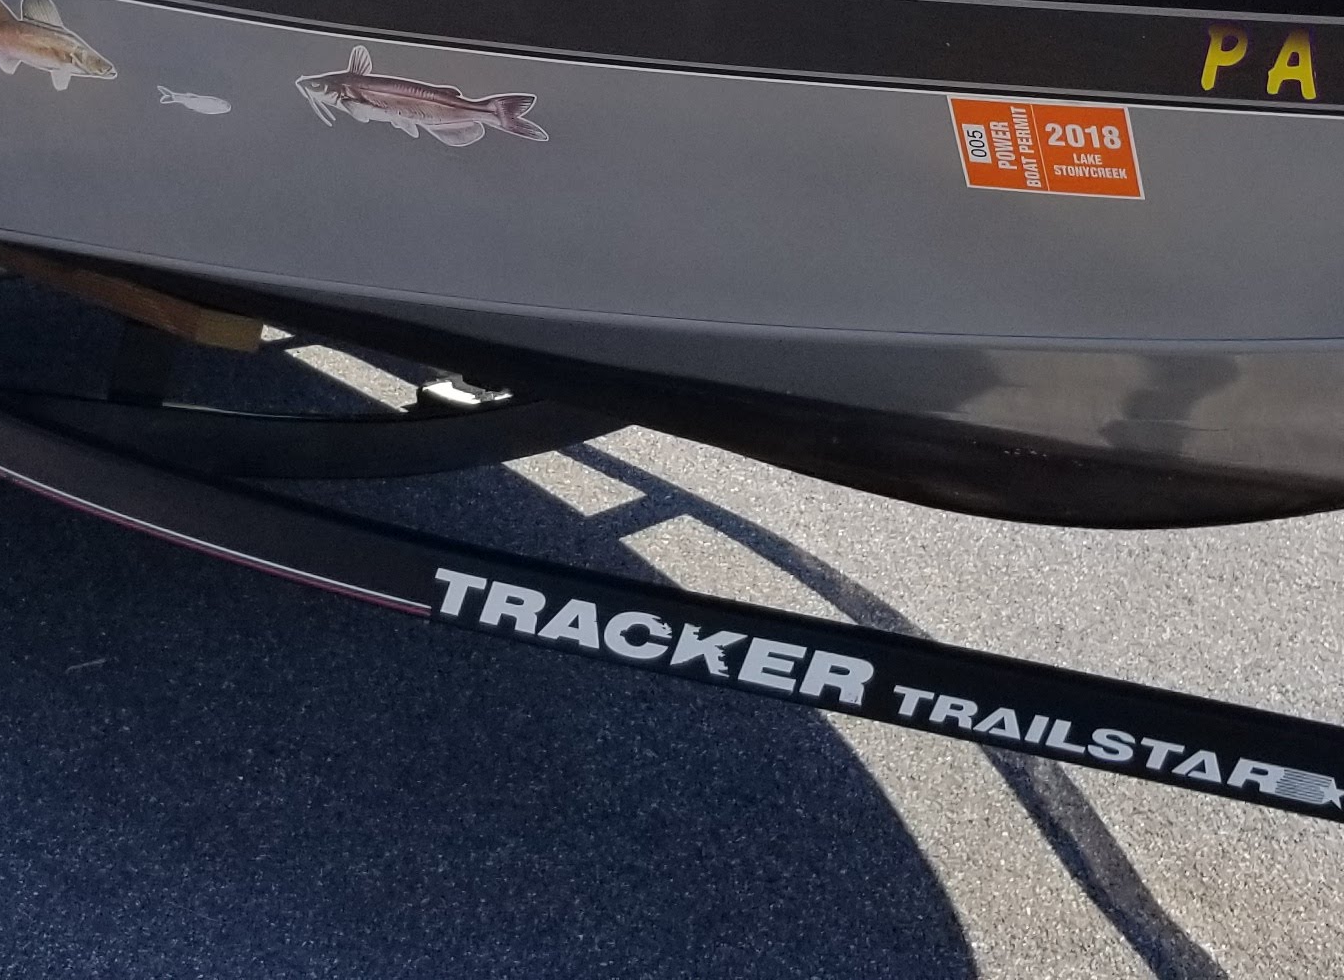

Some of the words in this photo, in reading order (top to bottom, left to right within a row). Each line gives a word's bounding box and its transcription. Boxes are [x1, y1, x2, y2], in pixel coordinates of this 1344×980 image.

[1200, 23, 1317, 100] PA
[966, 129, 988, 159] 005
[989, 120, 1018, 170] POWER
[1010, 105, 1035, 154] PERMIT
[1044, 122, 1123, 150] 2018
[1021, 155, 1042, 188] BOAT
[1053, 165, 1128, 179] STONYCREEK
[1072, 153, 1103, 166] LAKE
[433, 567, 874, 706] TRACKER
[893, 684, 1290, 798] TRAILSTAR
